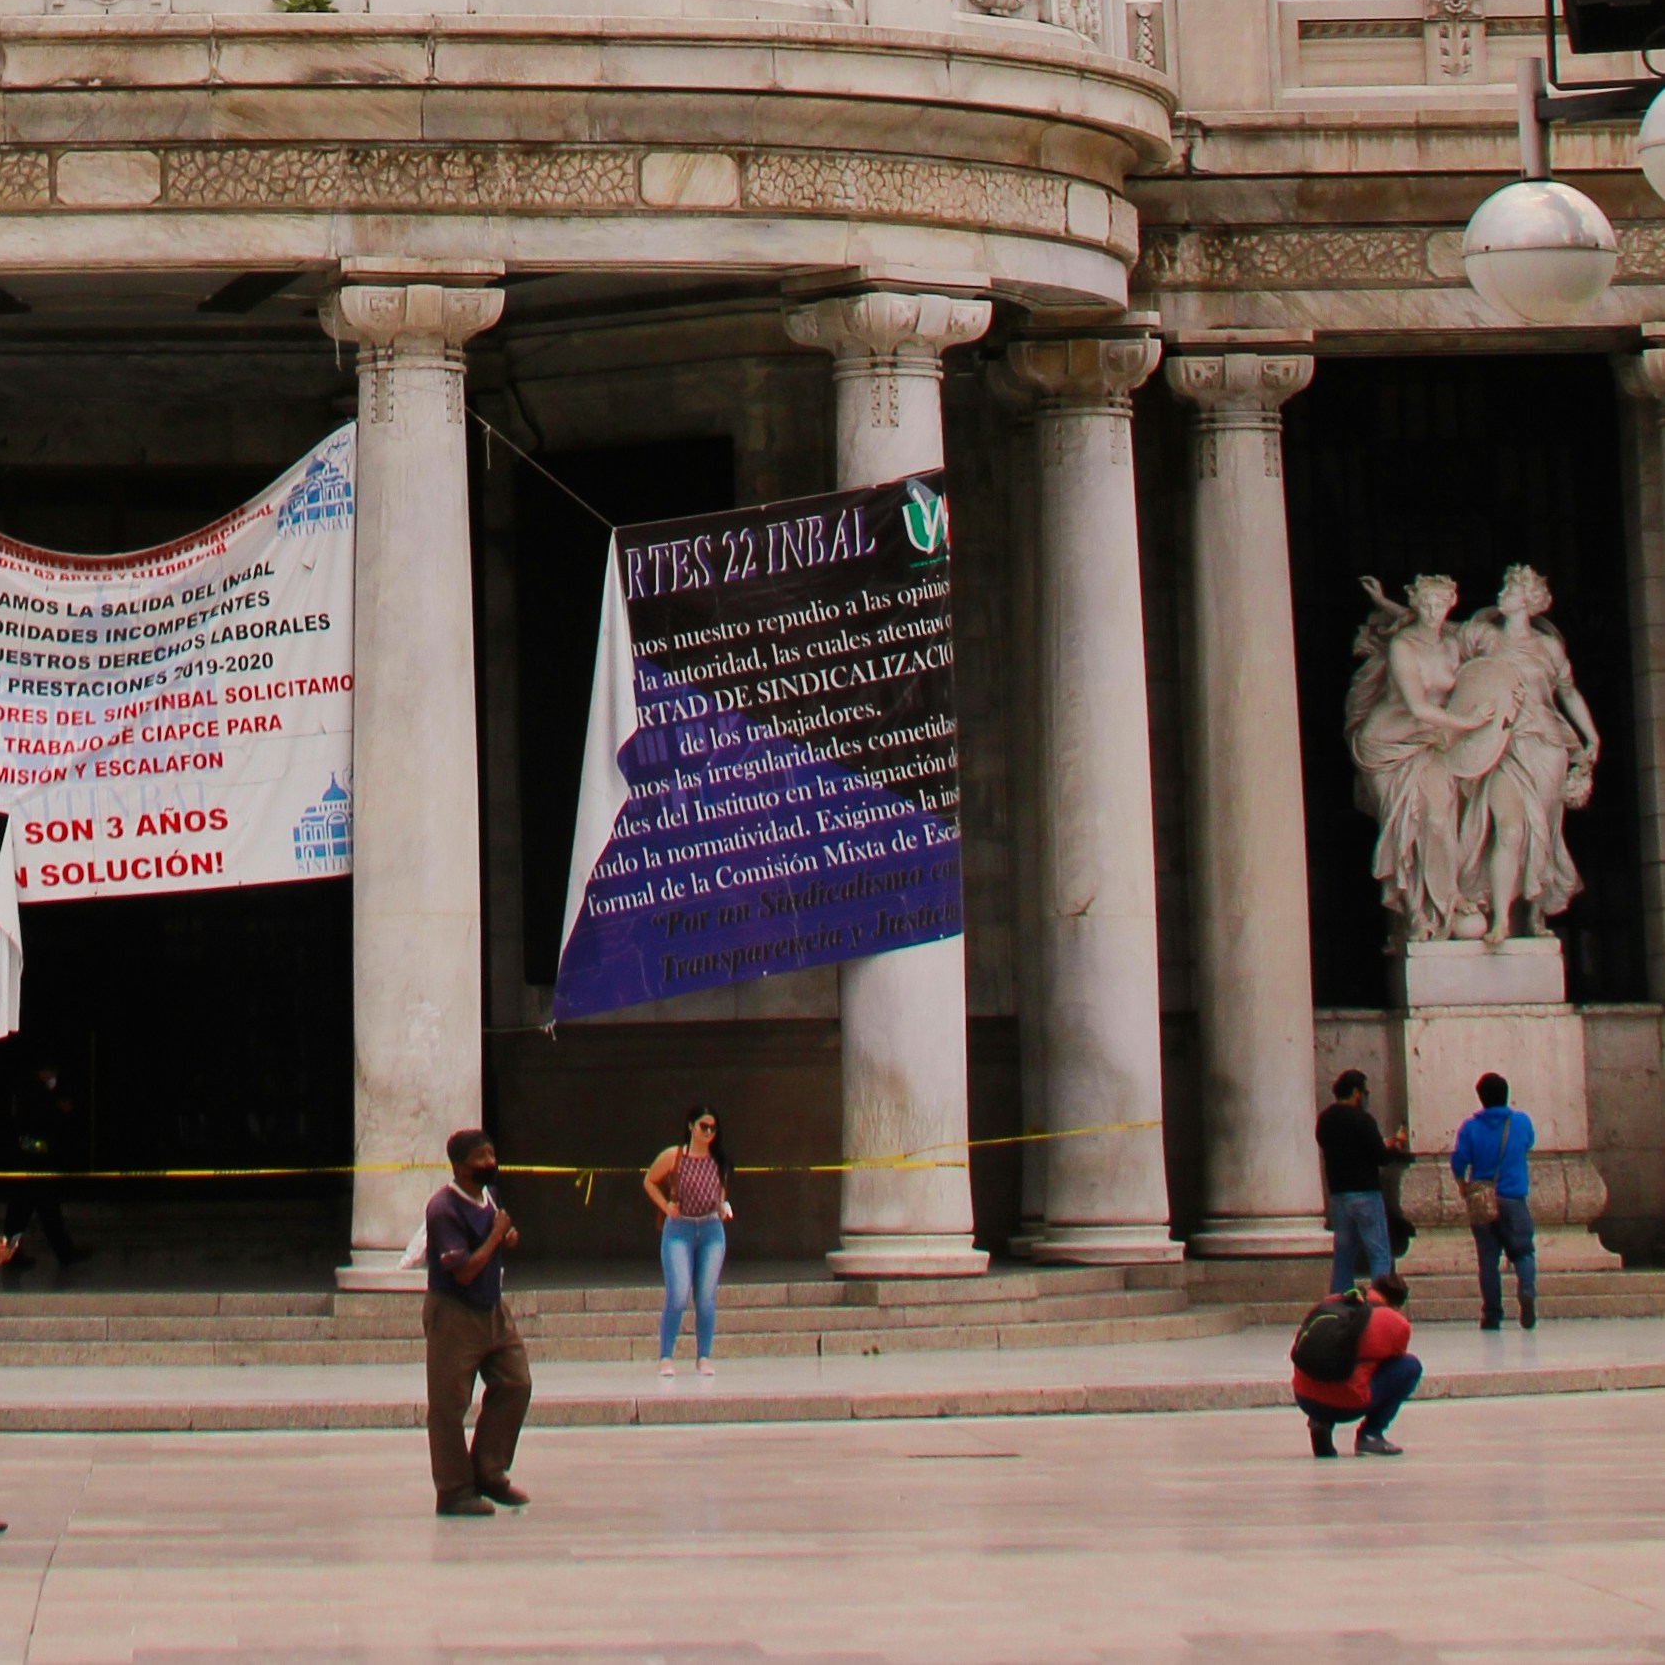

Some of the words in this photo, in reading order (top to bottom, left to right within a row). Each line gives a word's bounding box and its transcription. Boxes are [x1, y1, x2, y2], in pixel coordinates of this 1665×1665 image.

[624, 533, 714, 601] RTES
[721, 526, 759, 584] 22
[765, 505, 877, 576] INBAL
[66, 602, 93, 618] LA
[101, 594, 175, 618] SALIDA
[182, 582, 216, 605] DEL
[105, 590, 271, 644] INCOMPETENTES
[673, 619, 750, 651] nuestro
[756, 599, 840, 635] repudio
[845, 599, 858, 617] a
[861, 589, 892, 613] las
[98, 633, 205, 669] DERECHOS
[210, 613, 331, 645] LABORALES
[638, 669, 659, 692] la
[662, 646, 768, 689] autoridad,
[771, 642, 801, 666] las
[806, 629, 872, 659] cuales
[877, 616, 944, 645] atentan
[8, 670, 168, 698] PRESTACIONES
[173, 651, 274, 681] 2019-2020
[713, 684, 754, 713] DE
[4, 734, 103, 756] TRABAJO
[141, 720, 220, 743] CIAPCE
[227, 714, 283, 736] PARA
[55, 708, 97, 726] DEL
[679, 732, 705, 757] de
[709, 726, 742, 751] los
[745, 702, 882, 744] trabajadores.
[74, 762, 88, 779] Y
[95, 751, 224, 778] ESCALAFON
[674, 768, 702, 791] las
[706, 736, 863, 785] irregularidades
[655, 802, 689, 831] del
[693, 791, 780, 823] Instituto
[785, 784, 813, 804] en
[816, 774, 837, 798] la
[842, 753, 947, 791] asignación
[25, 817, 93, 845] SON
[105, 816, 125, 839] 3
[135, 806, 229, 837] AÑOS
[642, 846, 662, 870] la
[666, 814, 812, 865] normatividad.
[815, 799, 916, 834] Exigimos
[918, 788, 938, 812] la
[40, 850, 224, 888] SOLUCIÓN!
[587, 880, 656, 918] formal
[660, 876, 686, 902] de
[690, 871, 712, 896] la
[714, 852, 819, 891] Comisión
[822, 838, 888, 869] Mixta
[890, 828, 919, 854] de
[717, 901, 752, 925] un
[757, 864, 924, 919] Sindicalismo
[658, 923, 844, 984] Transparencia
[847, 921, 864, 951] y
